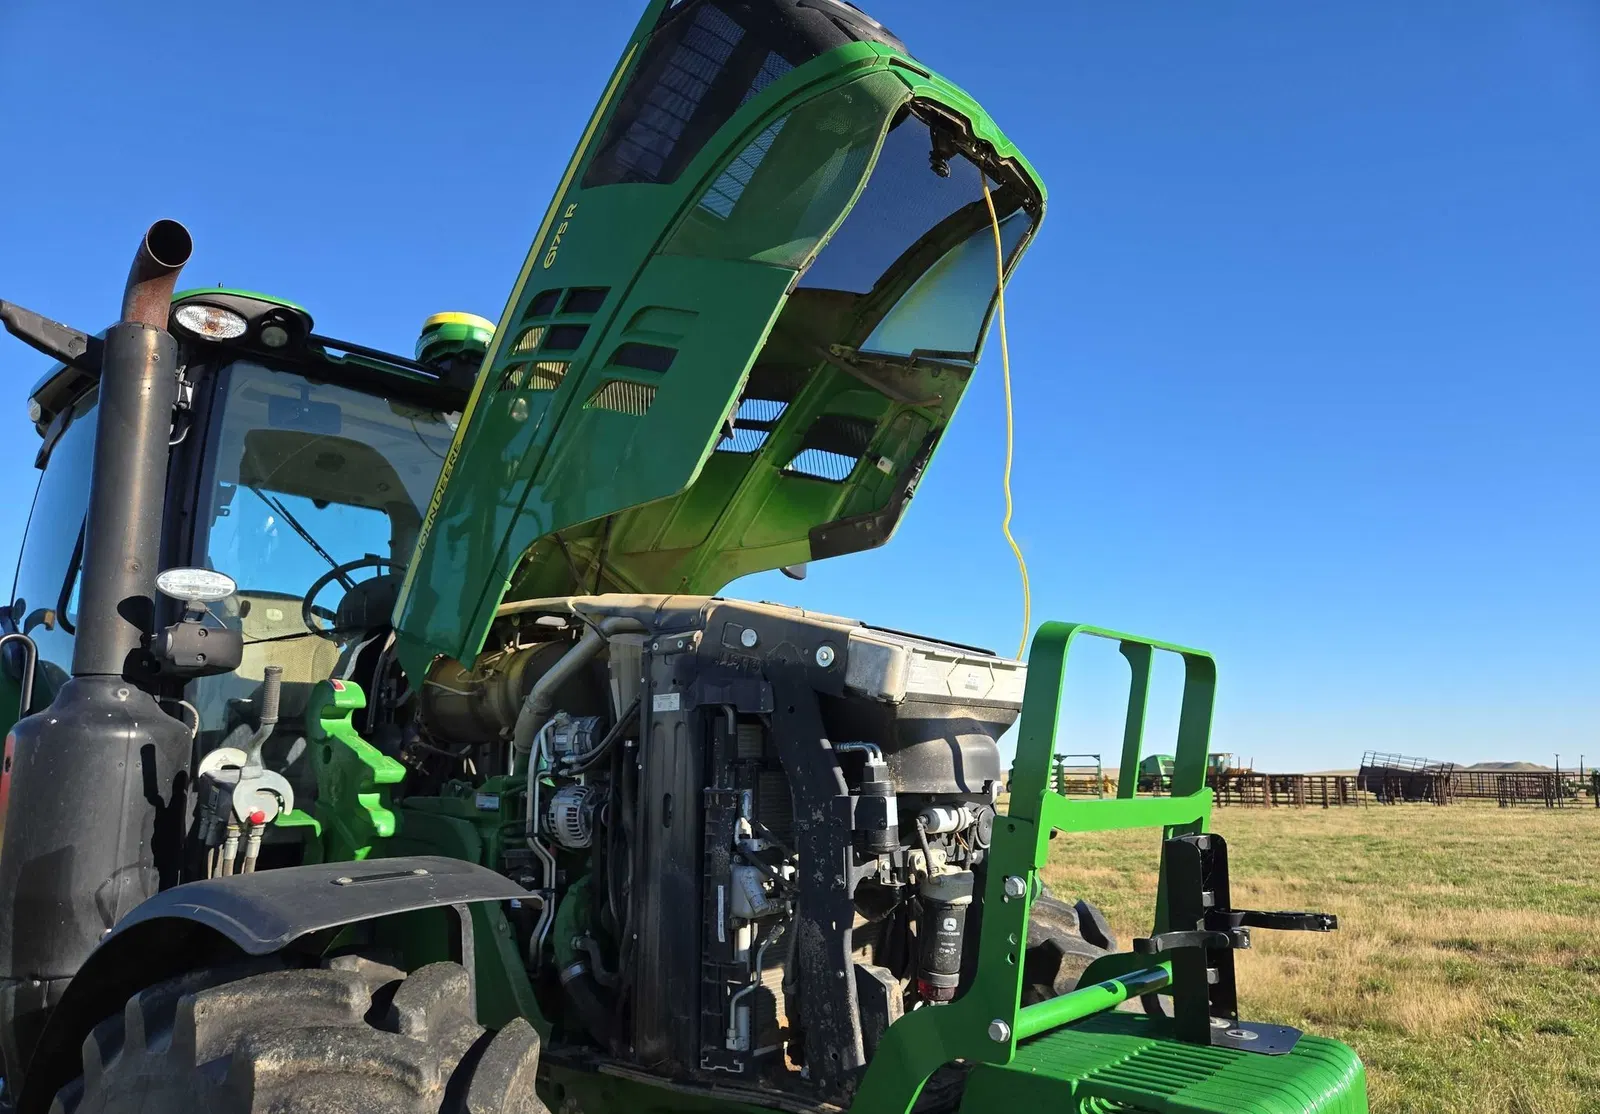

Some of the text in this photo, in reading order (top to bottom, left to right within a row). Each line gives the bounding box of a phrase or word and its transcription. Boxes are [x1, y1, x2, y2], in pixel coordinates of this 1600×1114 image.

[543, 203, 578, 269] 6175 R
[418, 440, 462, 552] JOHN DEERE
